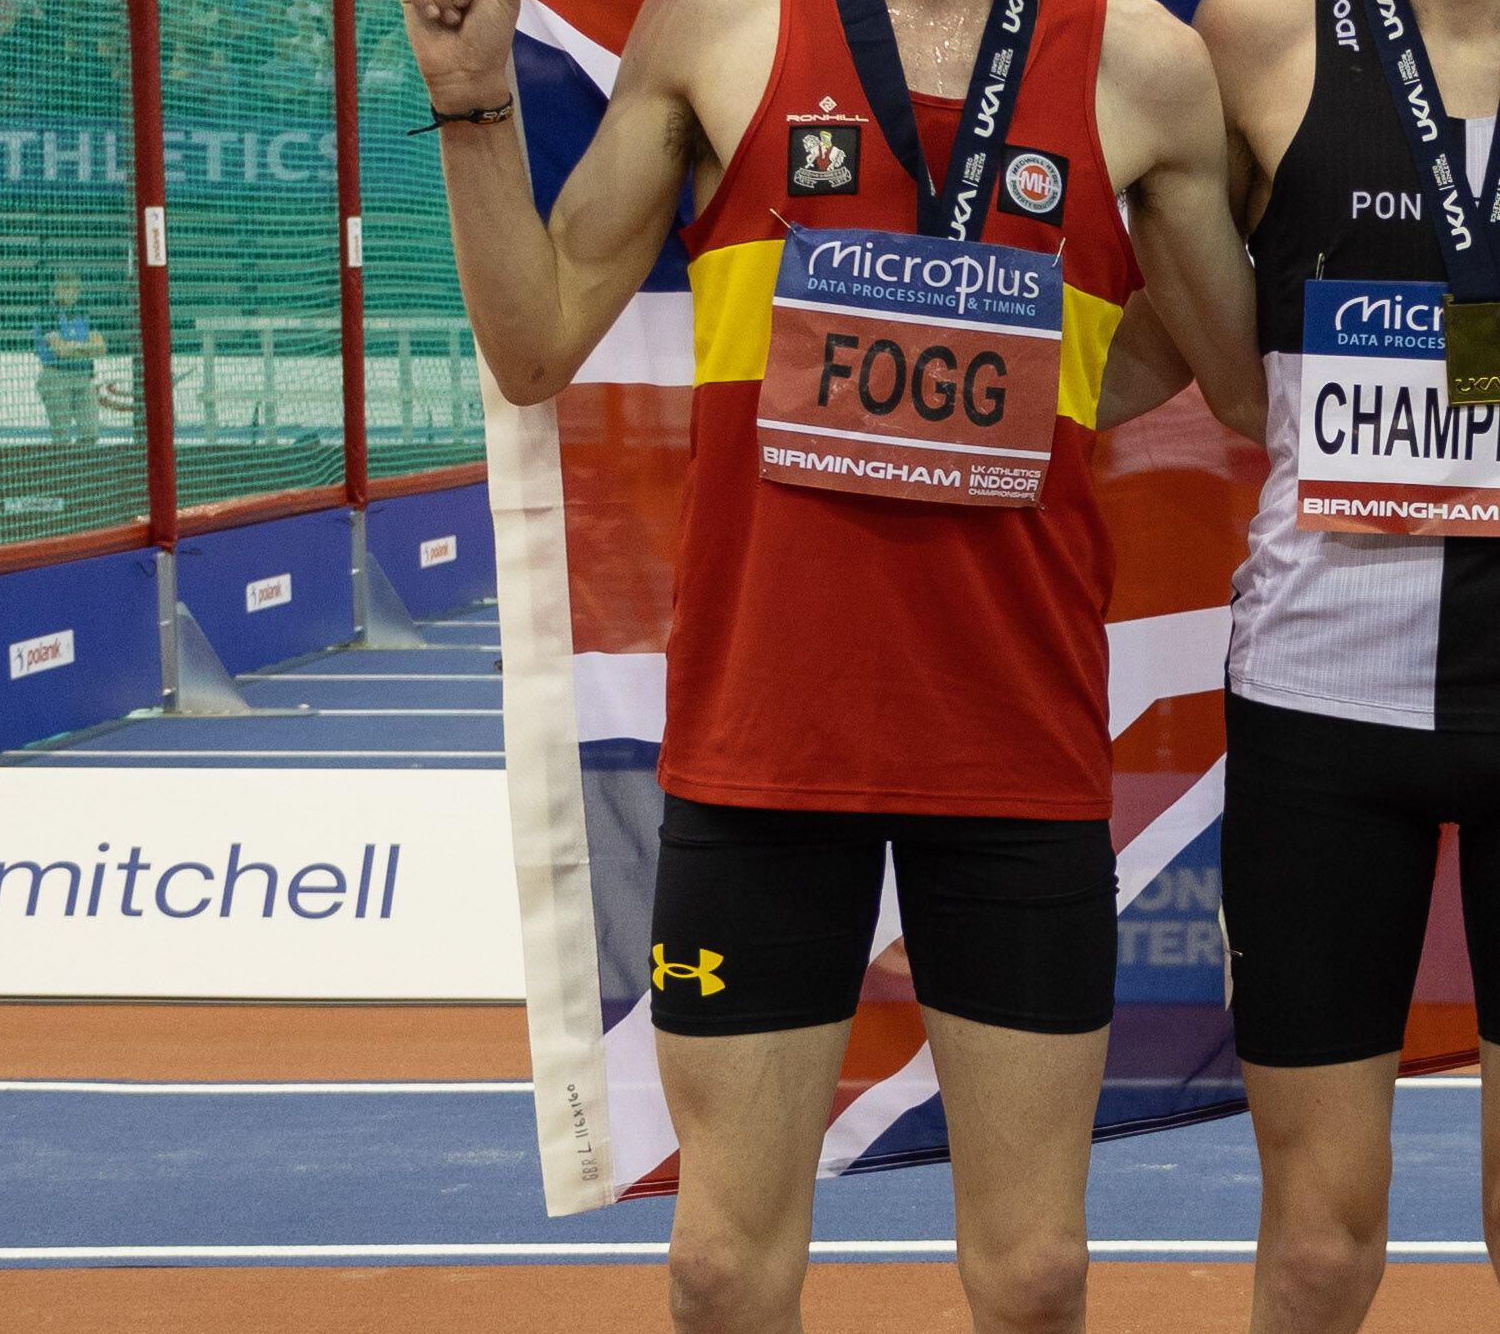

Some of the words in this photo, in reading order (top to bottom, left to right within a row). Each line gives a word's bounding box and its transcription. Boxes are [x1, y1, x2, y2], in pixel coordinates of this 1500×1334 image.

[786, 113, 869, 123] RONHILL
[974, 83, 1005, 138] UKA
[1407, 83, 1438, 142] UKA
[1018, 169, 1051, 197] MH
[948, 189, 978, 242] UKA
[1442, 190, 1472, 251] UKA
[807, 239, 1041, 315] Microplus
[807, 277, 848, 295] DATA
[851, 282, 957, 309] PROCESSING
[967, 296, 979, 311] &
[982, 298, 1037, 317] TIMING
[1337, 333, 1378, 347] DATA
[1384, 335, 1446, 350] PROCES
[817, 332, 1008, 428] FOGG
[762, 446, 962, 489] BIRMINGHAM
[969, 473, 1039, 493] INDOOR
[970, 464, 988, 477] UK
[987, 464, 1042, 481] ATHLETICS
[1303, 497, 1499, 522] BIRMINGHAM
[26, 641, 62, 666] polanik
